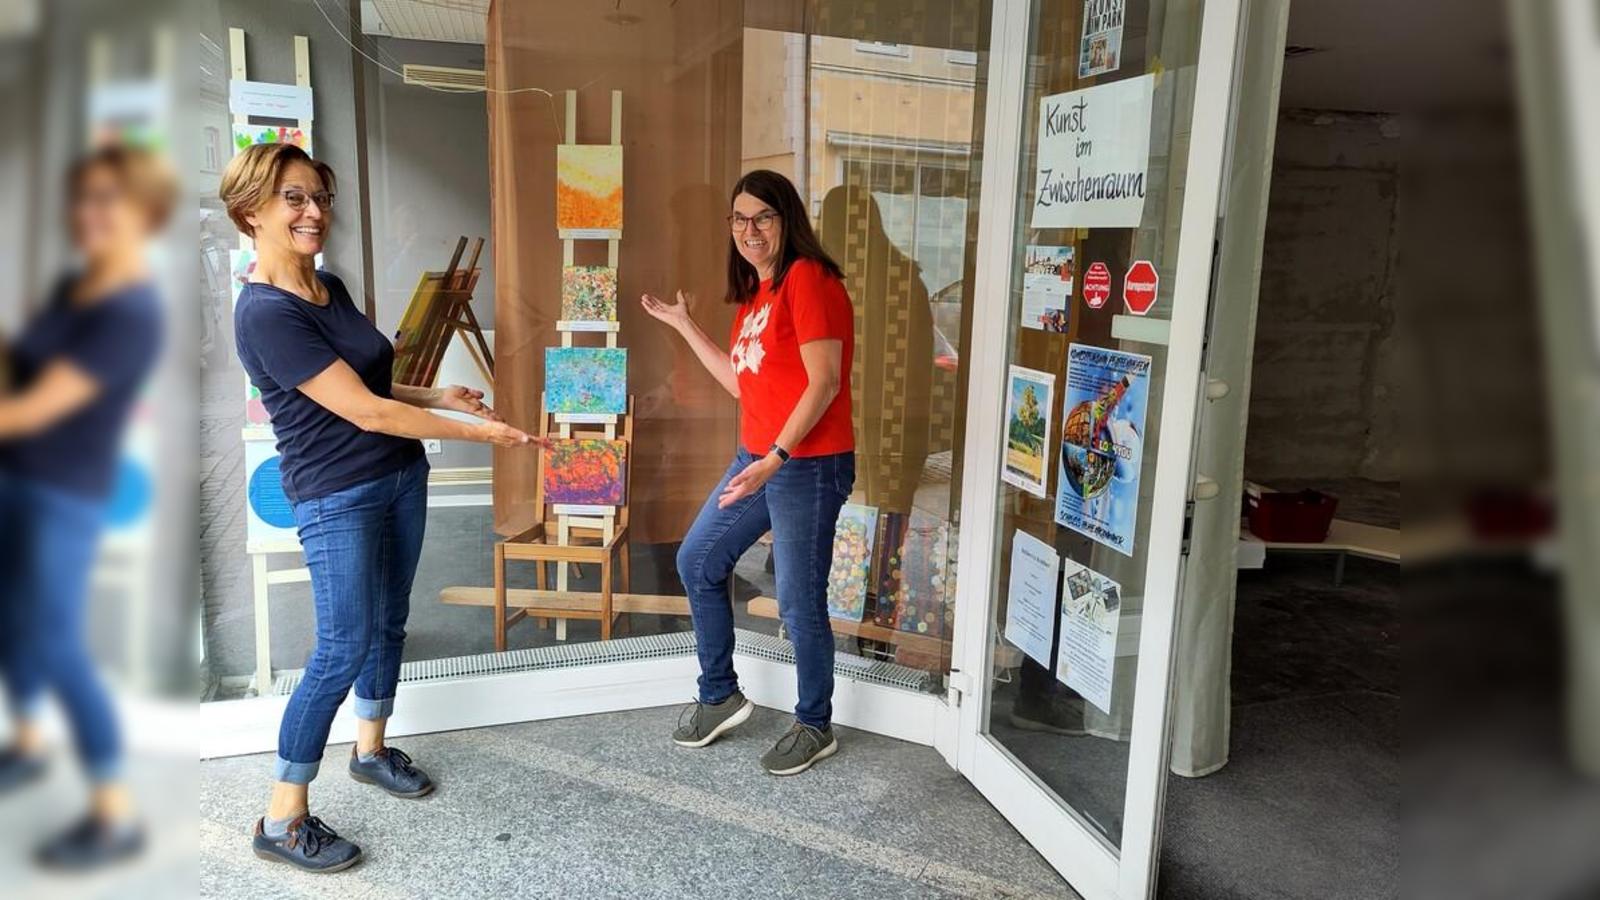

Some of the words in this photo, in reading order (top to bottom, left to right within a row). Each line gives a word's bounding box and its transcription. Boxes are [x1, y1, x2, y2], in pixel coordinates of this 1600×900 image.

[1101, 9, 1122, 30] PARK
[1045, 95, 1088, 137] Kunst
[1075, 137, 1092, 158] im
[1036, 166, 1145, 207] Zwischenraum
